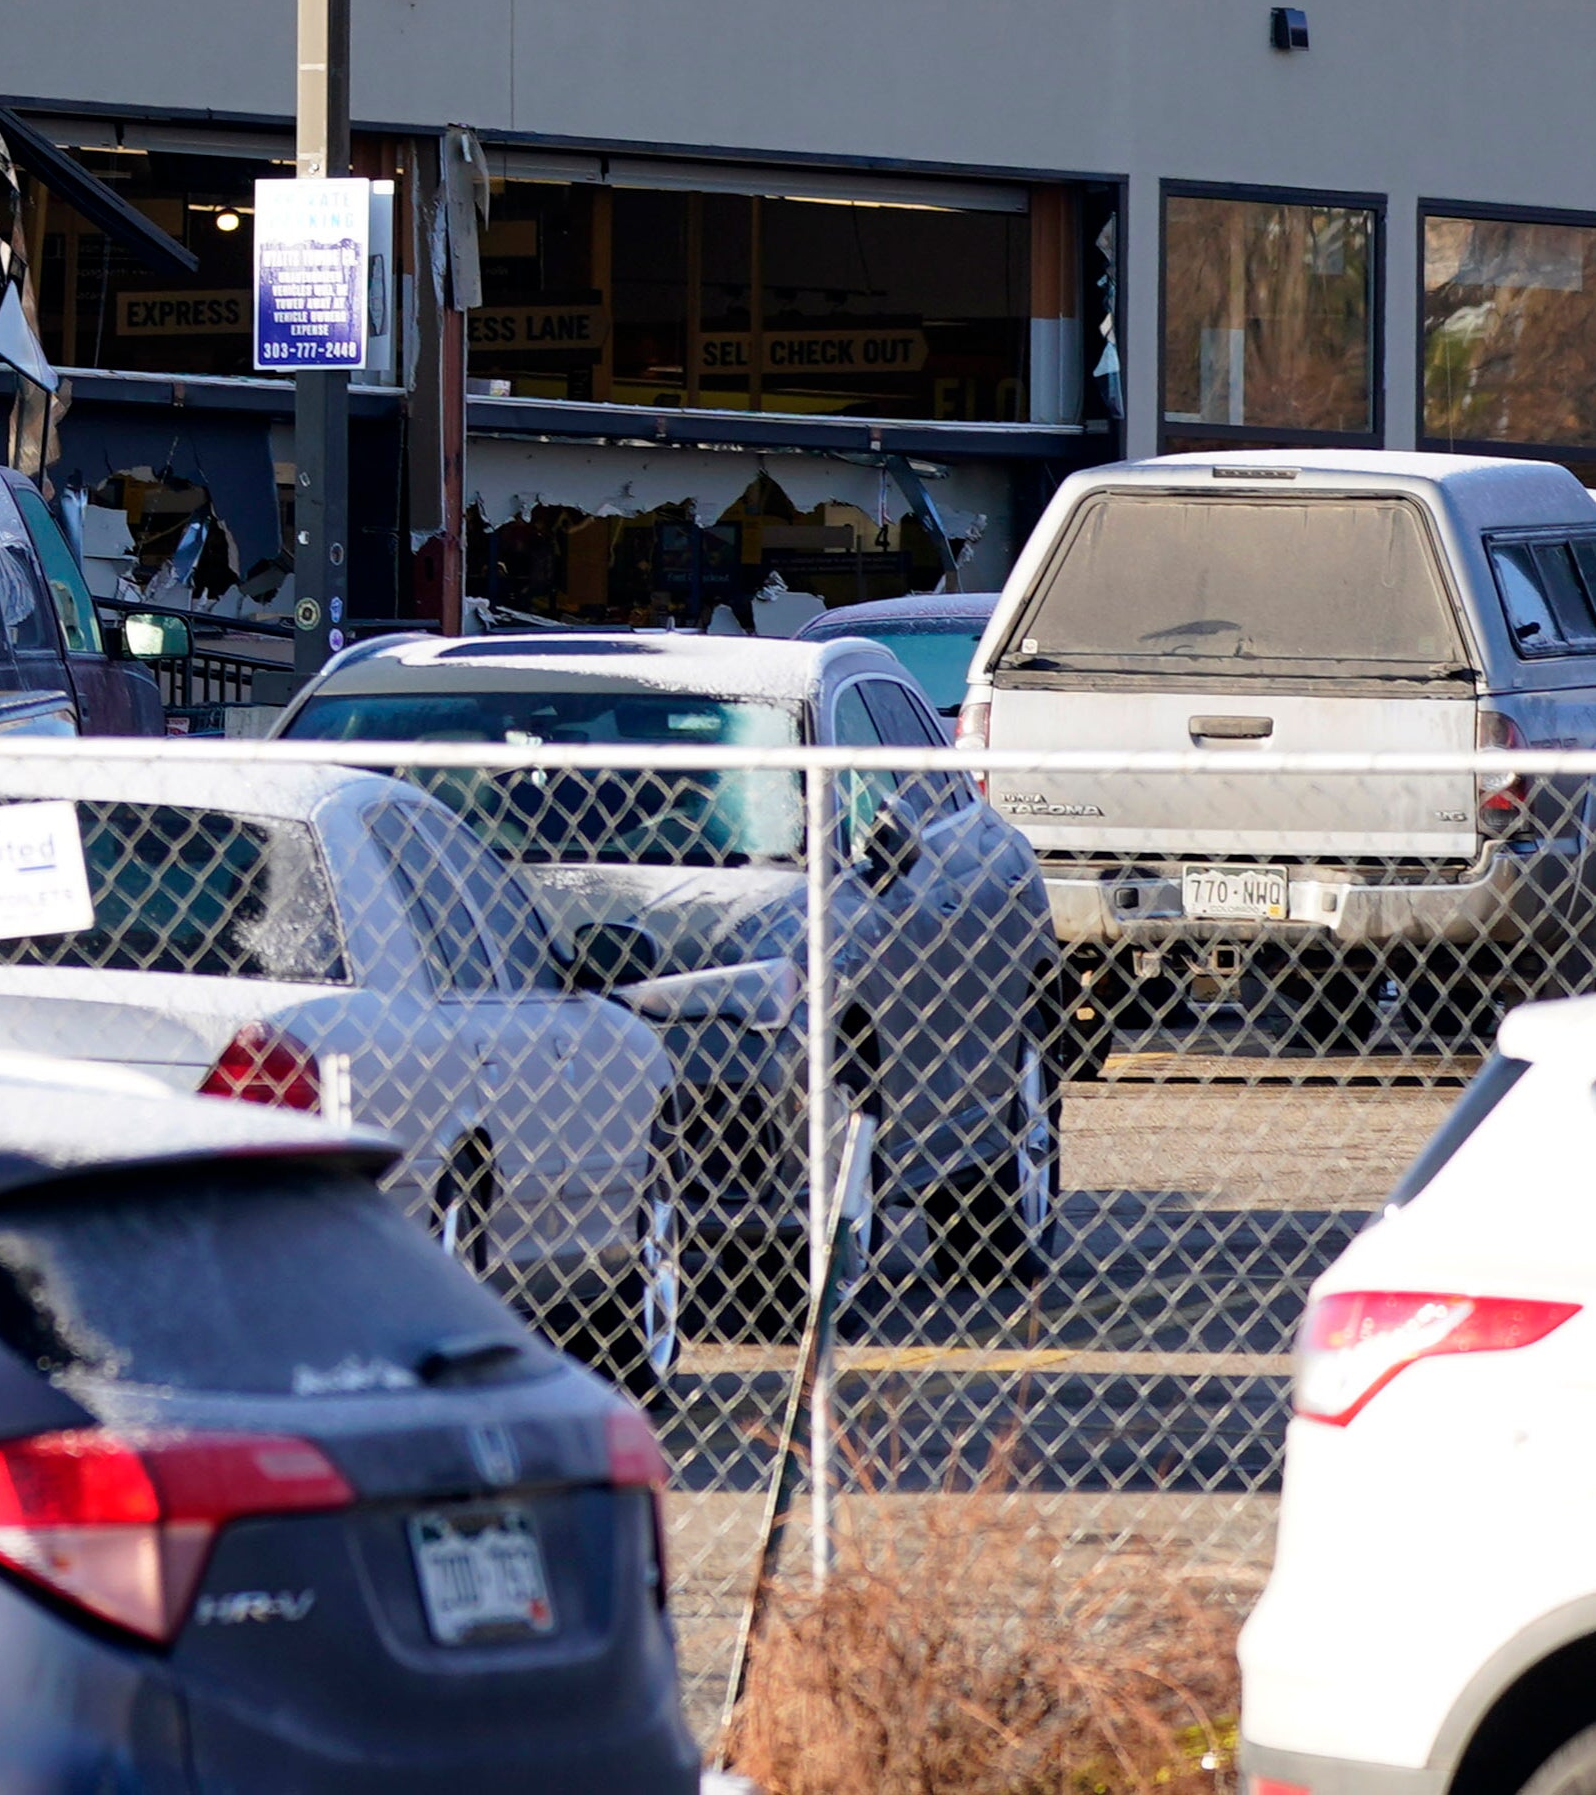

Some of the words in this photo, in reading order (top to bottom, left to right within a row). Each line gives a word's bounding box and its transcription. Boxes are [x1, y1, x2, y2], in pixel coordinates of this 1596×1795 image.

[275, 298, 306, 310] TOWED
[127, 299, 239, 328] EXPRESS
[274, 311, 308, 323] VEHICLE
[291, 324, 329, 336] EXPENSE
[526, 315, 590, 341] LANE
[264, 342, 357, 359] 303-777-2448
[702, 341, 749, 367] SEL
[770, 339, 854, 364] CHECK
[863, 338, 914, 364] OUT
[1001, 804, 1106, 817] TACOMA
